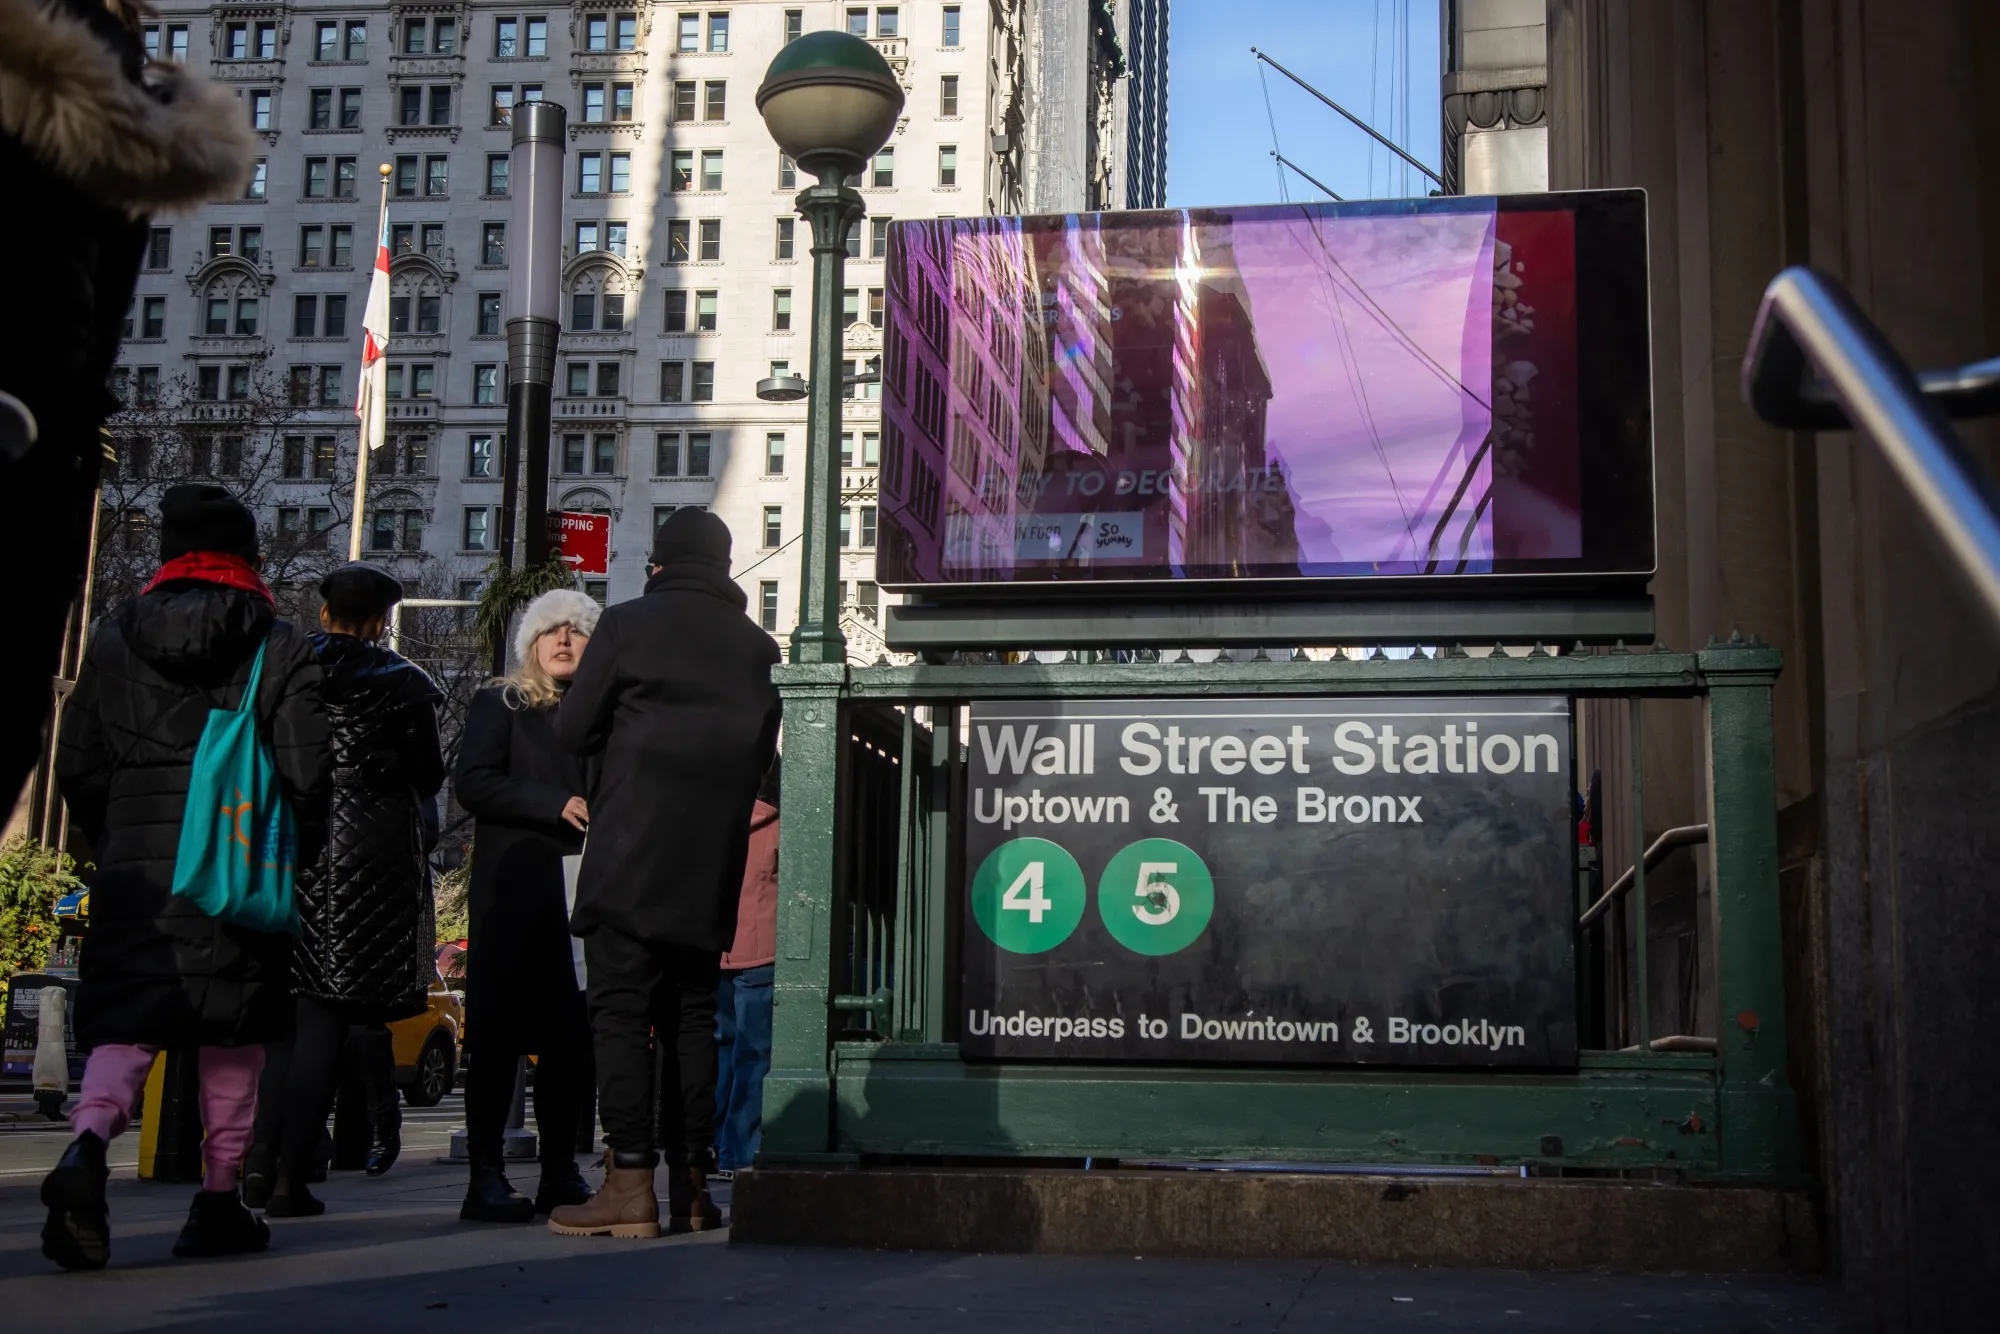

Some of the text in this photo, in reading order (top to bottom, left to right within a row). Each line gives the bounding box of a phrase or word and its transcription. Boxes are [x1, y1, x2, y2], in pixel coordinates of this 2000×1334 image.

[1065, 470, 1105, 497] TO
[548, 517, 594, 531] TOPPING
[977, 720, 1560, 777] Wall Street Station
[973, 786, 1424, 831] Uptown & The Bronx
[1001, 861, 1180, 925] 4 5
[968, 1009, 1526, 1051] Underpass to Downtown & Brooklyn
